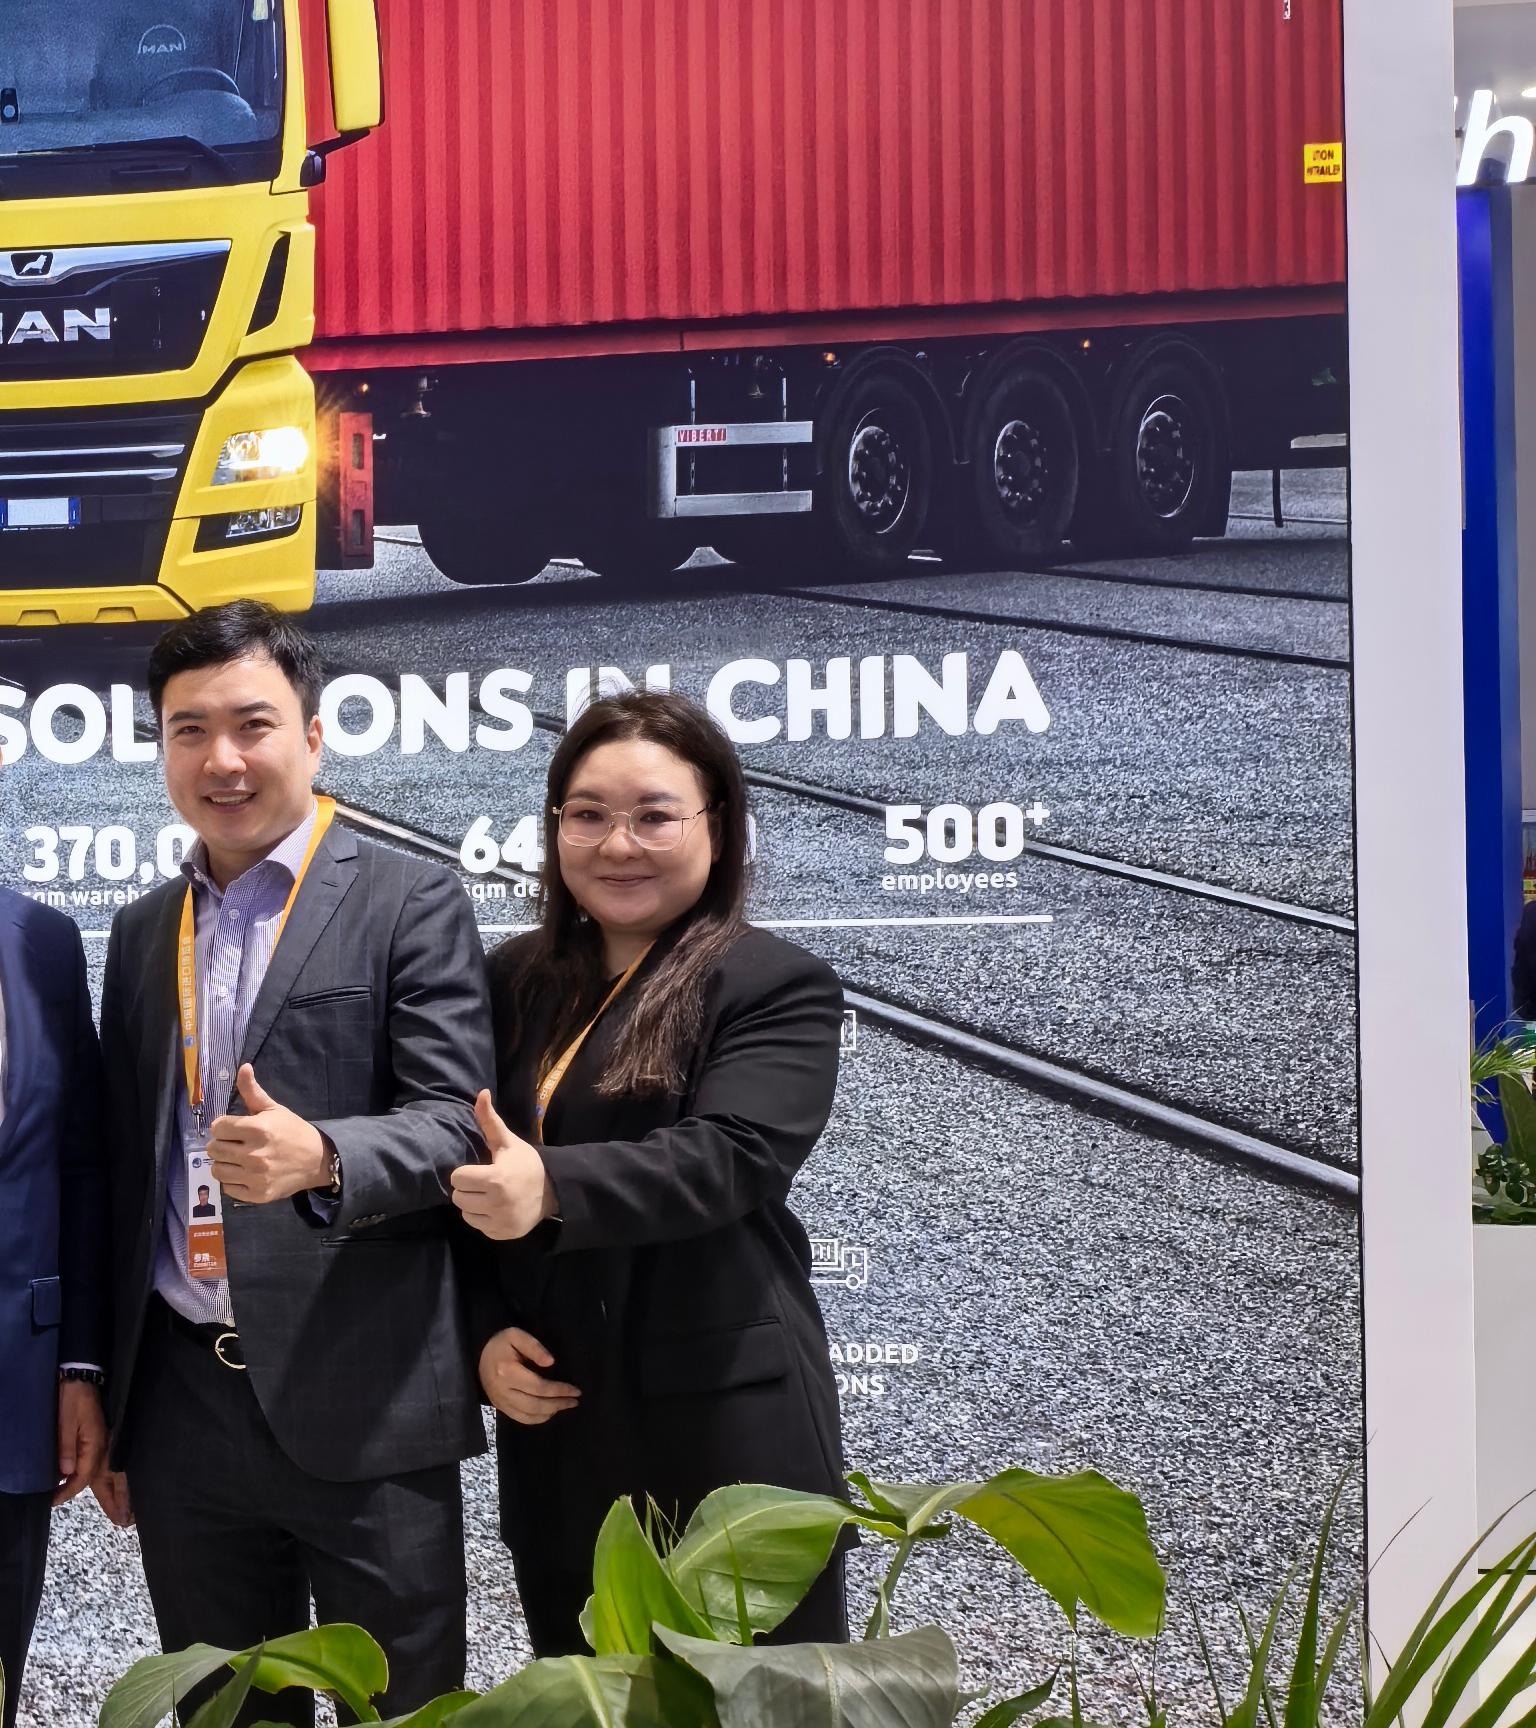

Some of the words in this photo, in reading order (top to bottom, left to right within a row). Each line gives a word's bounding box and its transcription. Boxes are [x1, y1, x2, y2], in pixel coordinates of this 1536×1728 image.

[143, 43, 182, 54] MAN
[706, 650, 1051, 744] CHINA
[882, 867, 1018, 894] employees
[71, 885, 151, 905] wareh
[829, 1343, 919, 1364] ADDED
